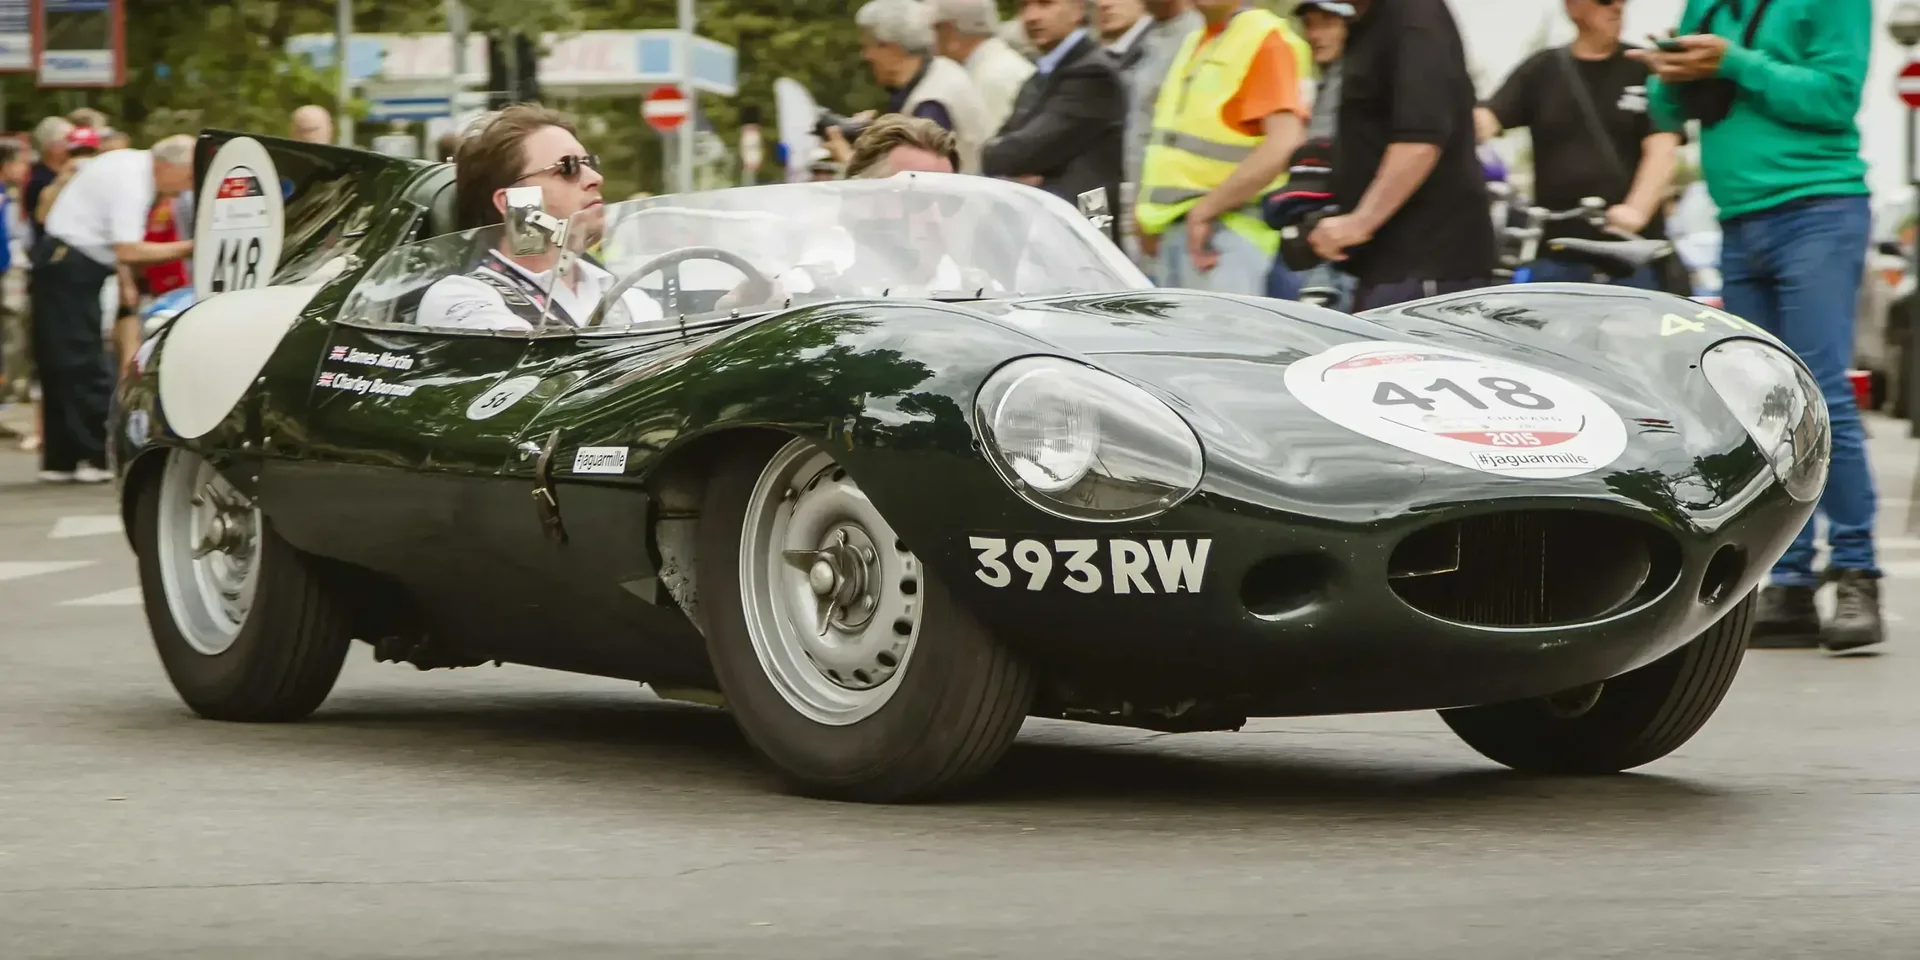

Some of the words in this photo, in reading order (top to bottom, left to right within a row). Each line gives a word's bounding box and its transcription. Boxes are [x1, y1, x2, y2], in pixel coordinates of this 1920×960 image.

[211, 237, 261, 292] 418
[1661, 310, 1776, 336] 41
[343, 347, 379, 365] James
[375, 351, 414, 370] Martin
[332, 372, 373, 395] Charley
[1372, 377, 1555, 411] 418
[481, 392, 514, 408] 56
[1485, 432, 1541, 446] 2015
[577, 450, 624, 470] #jaguarmille
[1478, 452, 1588, 468] #jaguarmille
